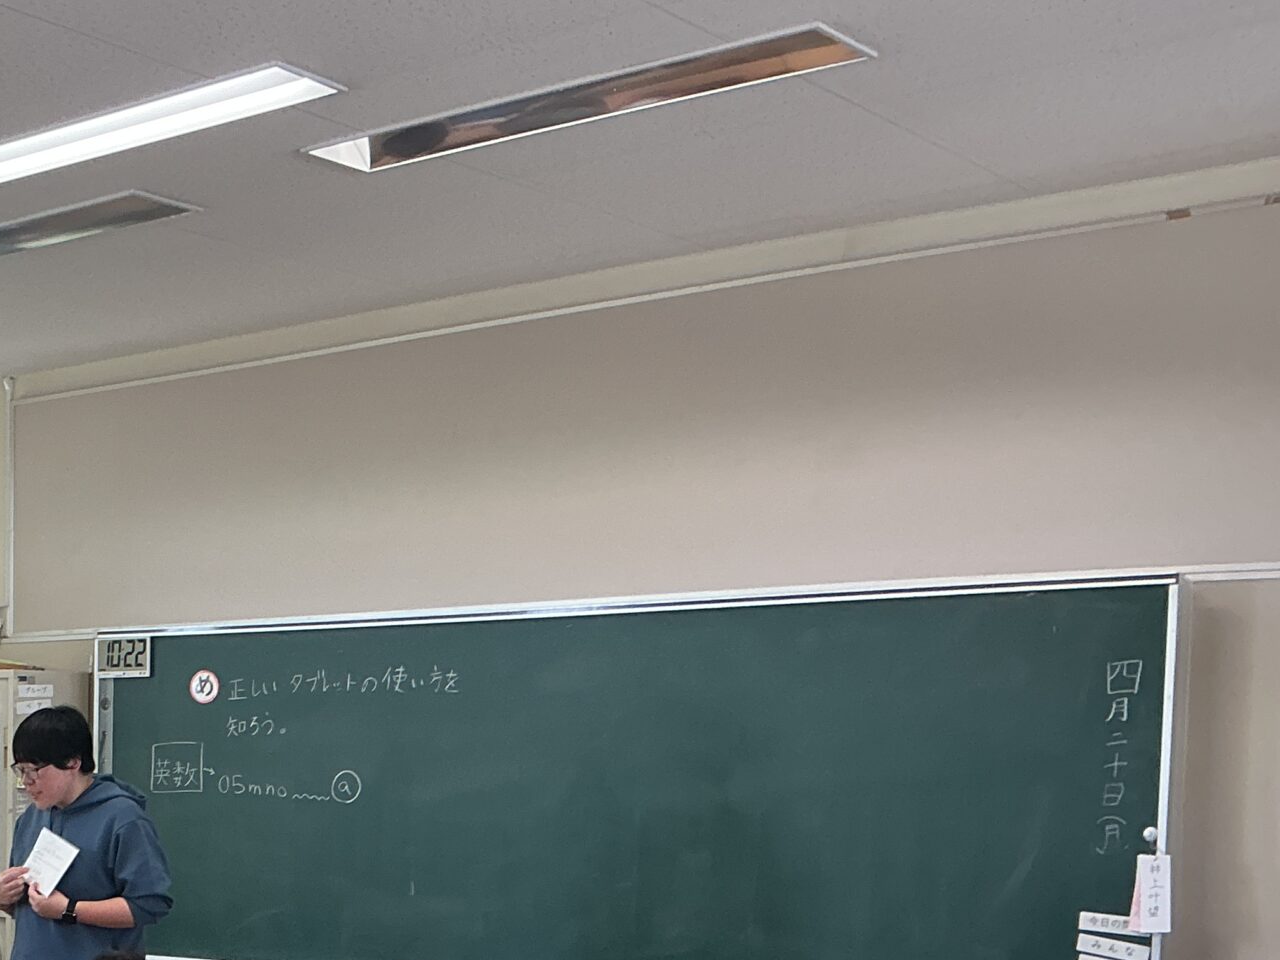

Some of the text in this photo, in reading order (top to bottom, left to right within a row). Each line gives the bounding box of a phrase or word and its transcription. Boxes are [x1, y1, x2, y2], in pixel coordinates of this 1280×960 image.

[154, 758, 197, 787] 英数
[1091, 939, 1135, 957] みんな
